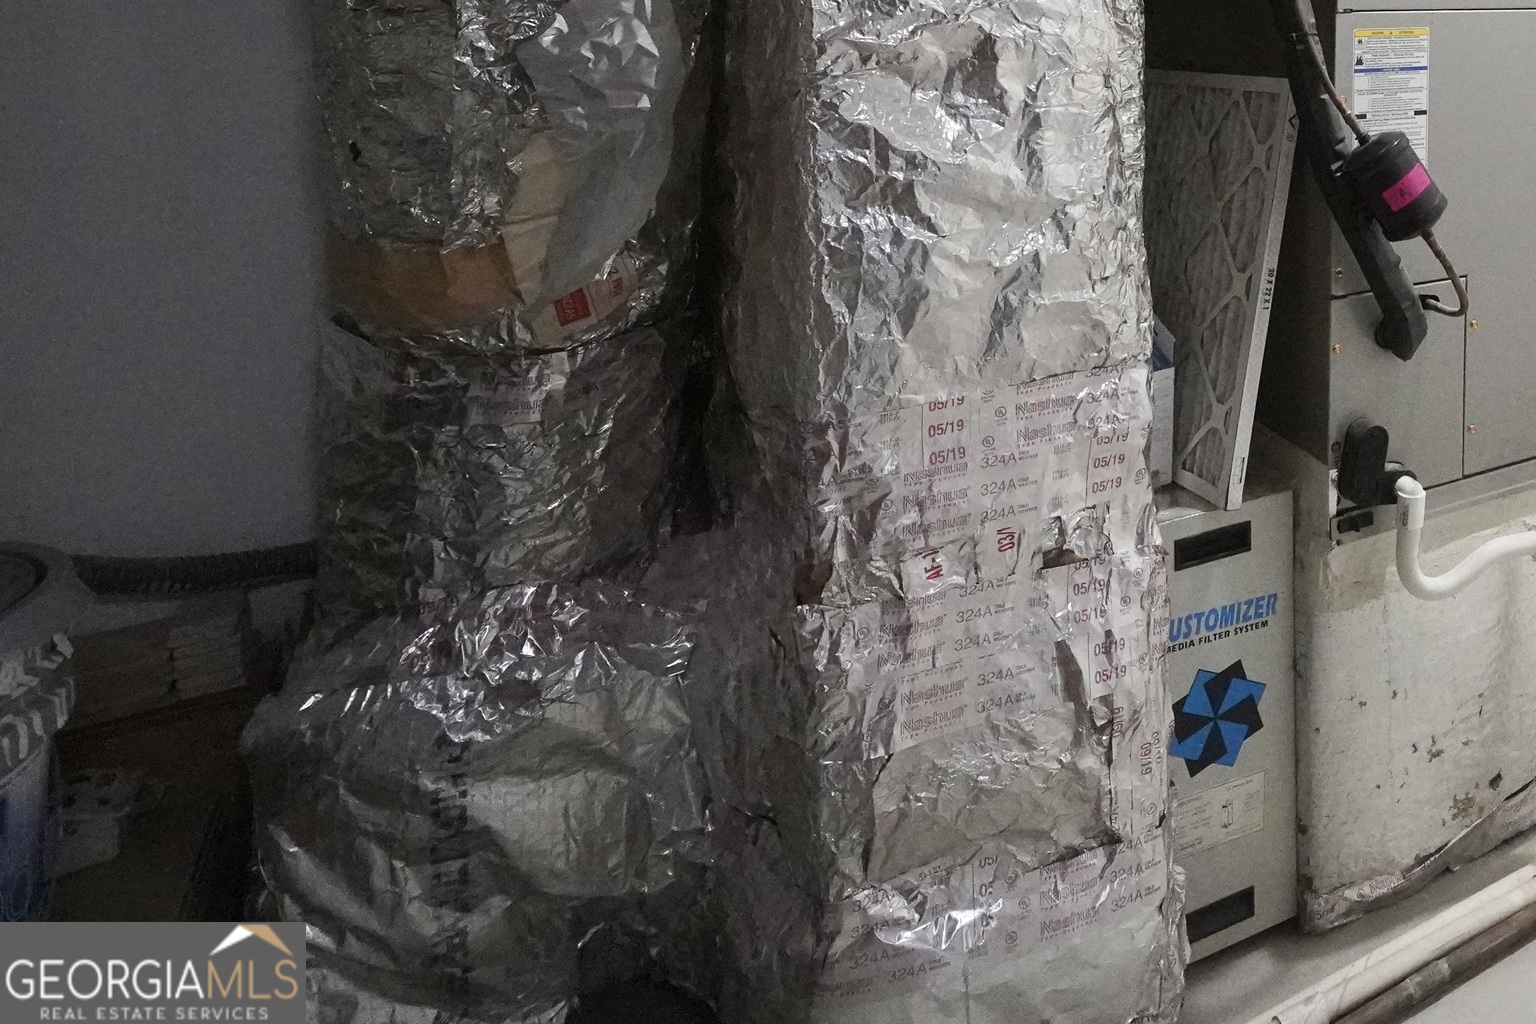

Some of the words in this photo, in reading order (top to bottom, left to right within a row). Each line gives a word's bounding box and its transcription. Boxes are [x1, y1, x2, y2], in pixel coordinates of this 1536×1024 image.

[1267, 268, 1275, 277] 20
[1015, 394, 1075, 416] Nashua
[1086, 388, 1120, 404] 324A
[928, 418, 964, 438] 05/19
[1016, 421, 1077, 443] Nashua
[929, 446, 966, 466] 05/19
[981, 452, 1017, 469] 324A
[1093, 453, 1125, 469] 05/19
[980, 478, 1017, 497] 324A
[1091, 476, 1122, 494] 05/19
[902, 486, 968, 510] Nashua
[980, 505, 1016, 523] 324A
[902, 513, 968, 537] Nashua
[959, 580, 995, 598] 324A
[1072, 578, 1106, 596] 05/19
[956, 605, 993, 624] 324A
[1168, 592, 1278, 643] USTOMIZER
[954, 633, 992, 652] 324A
[1198, 629, 1231, 646] FILTER
[1233, 619, 1269, 636] SYSTEM
[1093, 637, 1126, 657] 05/19
[977, 666, 1014, 687] 324A
[1094, 664, 1127, 684] 05/19
[900, 679, 965, 706] Nashua
[976, 693, 1014, 714] 324A
[900, 705, 964, 734] Nashua
[1140, 741, 1153, 776] 09/19
[1109, 862, 1144, 883] 324A
[1039, 877, 1098, 906] Nashua
[1111, 886, 1143, 913] 324A
[1040, 905, 1098, 935] Nashua
